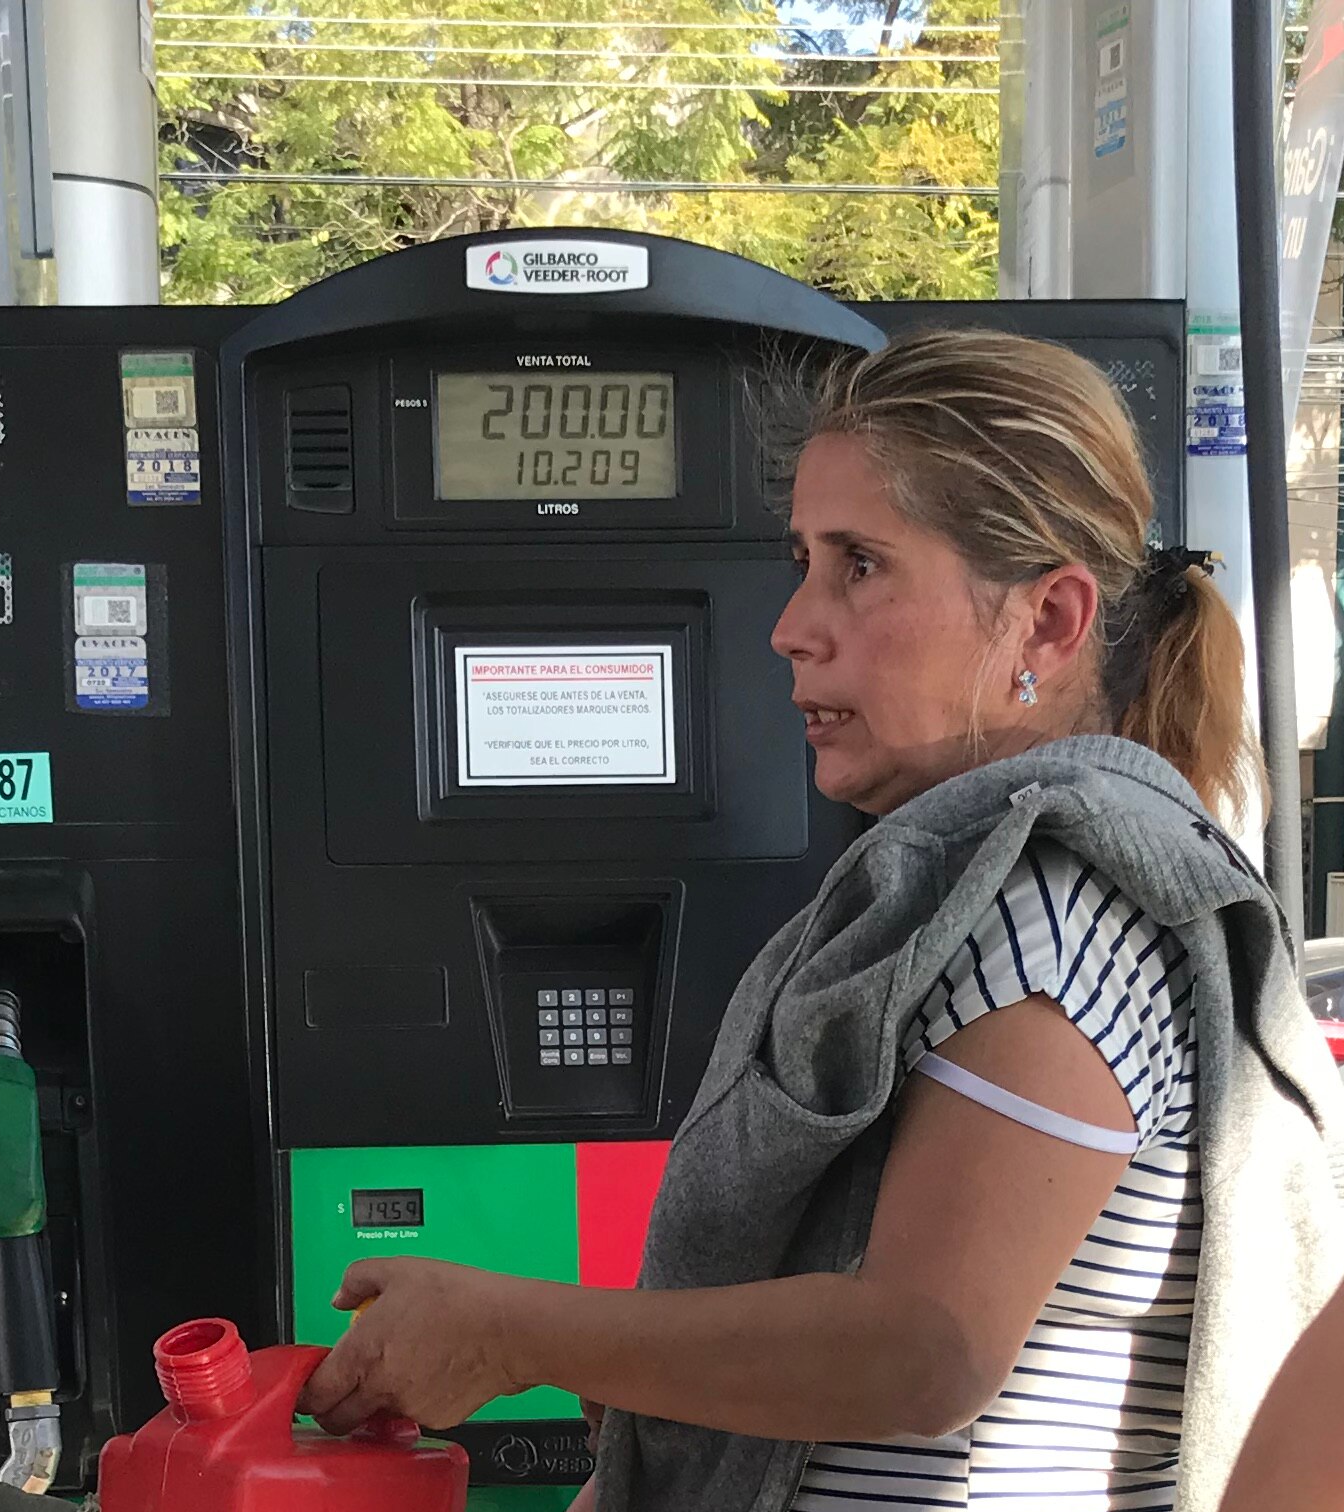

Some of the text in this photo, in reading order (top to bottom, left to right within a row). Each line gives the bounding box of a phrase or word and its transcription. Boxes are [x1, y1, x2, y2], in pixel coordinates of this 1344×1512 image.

[523, 253, 598, 266] GILBARCO
[523, 269, 629, 283] VEEDER-ROOT
[516, 355, 591, 367] VENTA TOTAL
[394, 400, 420, 408] PESOS
[482, 384, 669, 440] 200.00
[136, 461, 192, 473] 2018
[517, 450, 640, 486] 10.209
[537, 503, 579, 515] LITROS
[87, 667, 137, 678] 2017
[472, 664, 654, 676] IMPORTANTE PARA EL CONSUMIDOR
[540, 691, 558, 701] QUE
[560, 690, 588, 700] ANTES
[591, 690, 602, 700] DE
[604, 690, 615, 700] LA
[617, 690, 647, 700] VENTA,
[487, 706, 504, 716] LOS
[506, 705, 574, 715] TOTALIZADORES
[576, 704, 618, 714] MARQUEN
[534, 740, 552, 749] QUE
[555, 740, 565, 748] EL
[567, 739, 599, 749] PRECIO
[602, 739, 619, 748] POR
[622, 739, 649, 749] LITRO,
[530, 756, 609, 766] SEA EL CORRECTO
[592, 993, 598, 1001] 3
[569, 1013, 576, 1021] 5
[546, 1033, 553, 1041] 7
[594, 1032, 600, 1040] 9
[337, 1203, 345, 1214] $
[357, 1230, 418, 1239] Precio Por Litro
